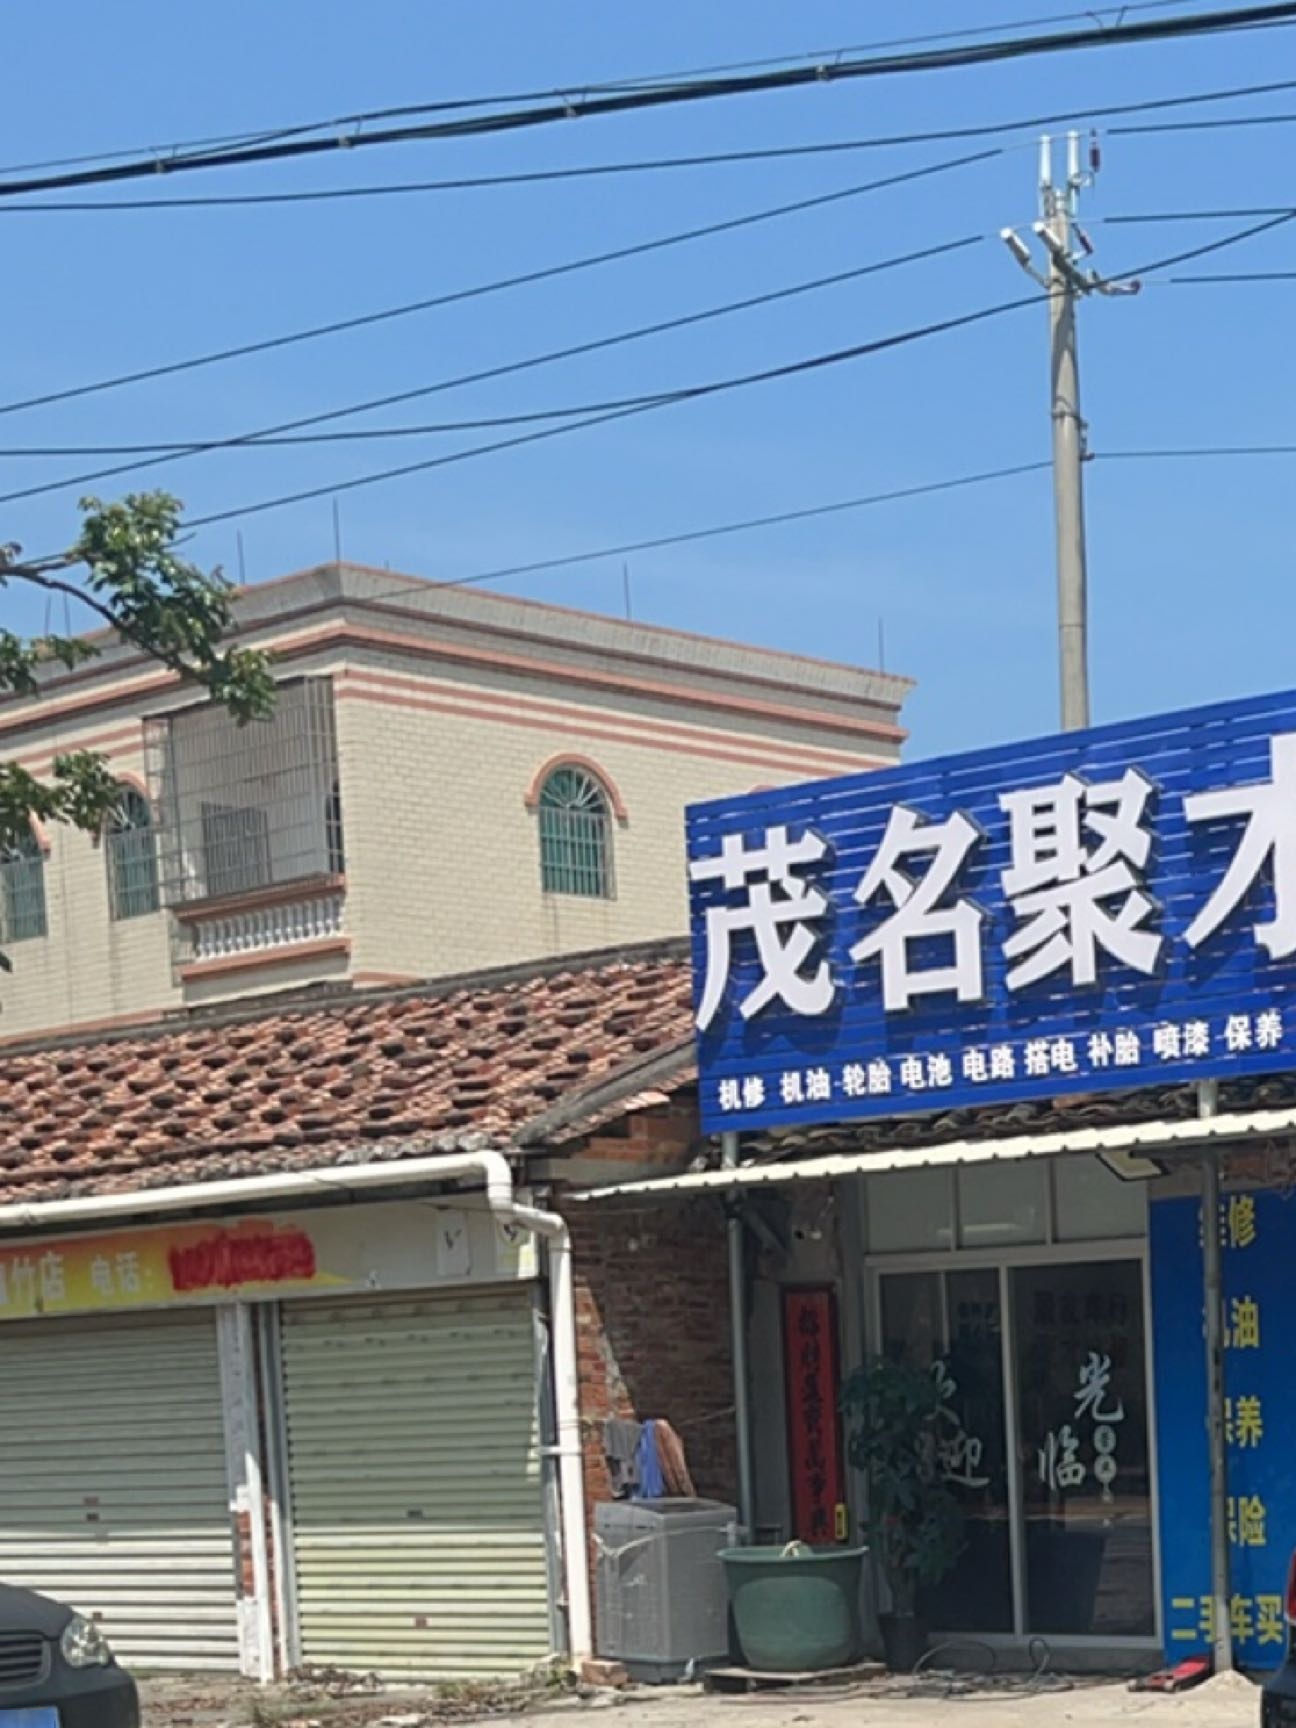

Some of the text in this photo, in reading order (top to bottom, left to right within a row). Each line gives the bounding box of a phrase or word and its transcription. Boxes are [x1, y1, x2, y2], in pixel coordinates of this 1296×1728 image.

[719, 1076, 766, 1110] 机修
[779, 1067, 831, 1104] 机油
[842, 1061, 892, 1096] 轮胎
[900, 1053, 953, 1090] 电池
[962, 1044, 1015, 1082] 电路
[1024, 1036, 1078, 1075] 搭电
[1087, 1030, 1140, 1067] 补胎
[1153, 1022, 1210, 1060] 喷漆
[1223, 1009, 1283, 1050] 保养
[0, 1251, 64, 1300] 竹店
